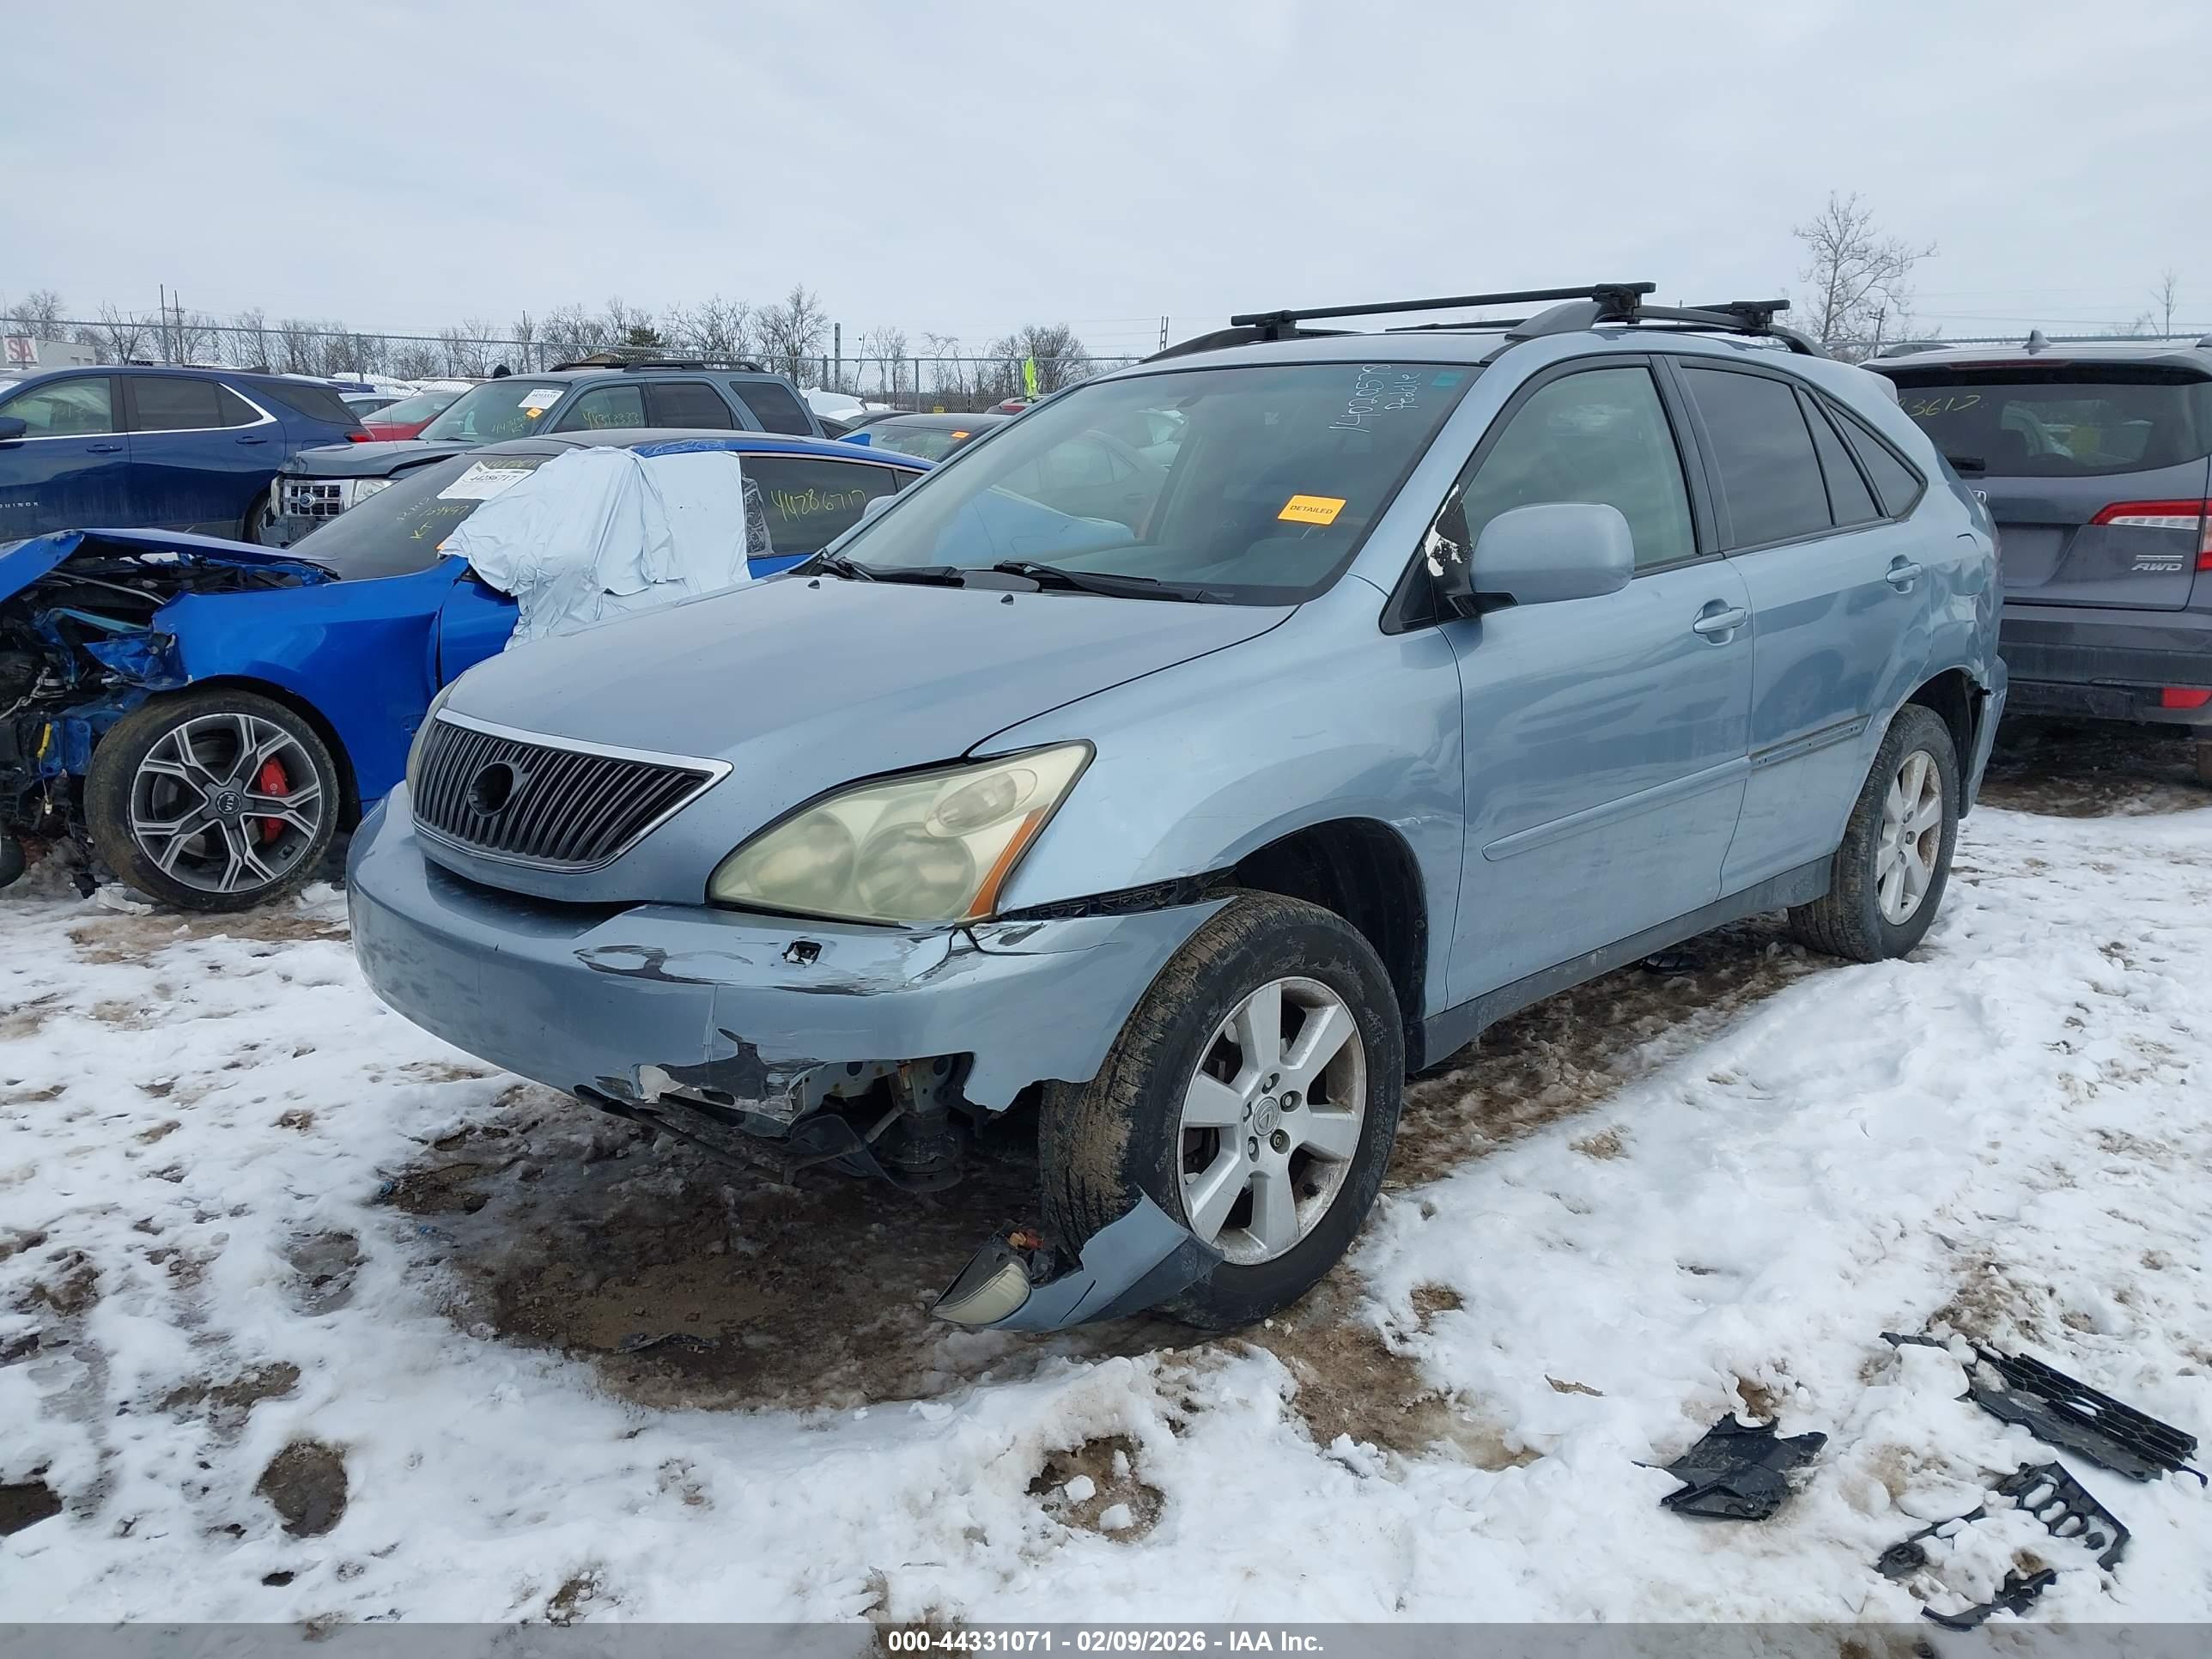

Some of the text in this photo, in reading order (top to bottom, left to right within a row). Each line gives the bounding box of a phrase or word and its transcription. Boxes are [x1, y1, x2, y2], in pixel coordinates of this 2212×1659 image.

[770, 488, 866, 522] 44286717
[1290, 505, 1334, 514] DETAILED
[2130, 562, 2183, 571] AWD
[224, 795, 234, 811] KIA
